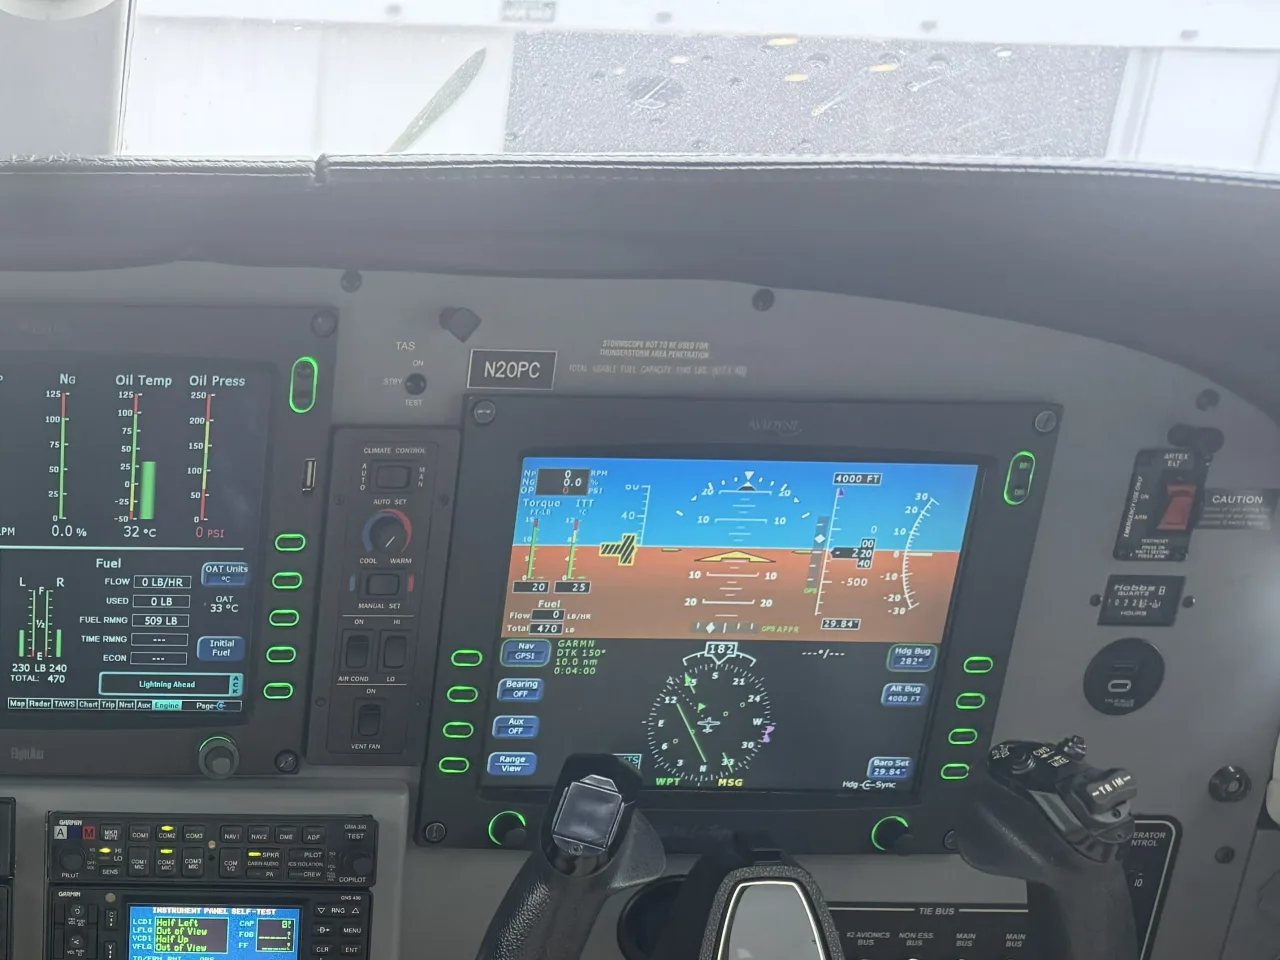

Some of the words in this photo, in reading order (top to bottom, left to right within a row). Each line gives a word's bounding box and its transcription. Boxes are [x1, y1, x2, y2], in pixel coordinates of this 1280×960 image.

[396, 342, 415, 350] TAS
[116, 375, 134, 386] Oil
[138, 375, 172, 388] Temp
[189, 375, 208, 386] Oil
[212, 376, 245, 387] Press
[1212, 496, 1263, 504] CAUTION
[124, 527, 140, 537] 32
[96, 558, 121, 568] Fuel
[152, 578, 183, 587] LB/HR
[104, 616, 128, 624] RMNG
[145, 616, 161, 625] 509
[163, 617, 177, 625] LB
[710, 644, 734, 654] 182
[895, 647, 911, 657] Hdg
[913, 648, 931, 657] Bug
[12, 664, 30, 672] 230
[34, 664, 46, 672] LB
[49, 664, 67, 672] 240
[554, 667, 596, 675] 0:04:00
[47, 675, 65, 683] 470
[139, 680, 171, 689] Lightning
[506, 680, 538, 689] Bearing
[155, 702, 178, 710] Engine
[874, 758, 892, 766] Baro
[656, 778, 680, 786] WPT
[718, 778, 743, 786] MSG
[919, 907, 932, 915] TIE
[935, 907, 955, 915] BUS
